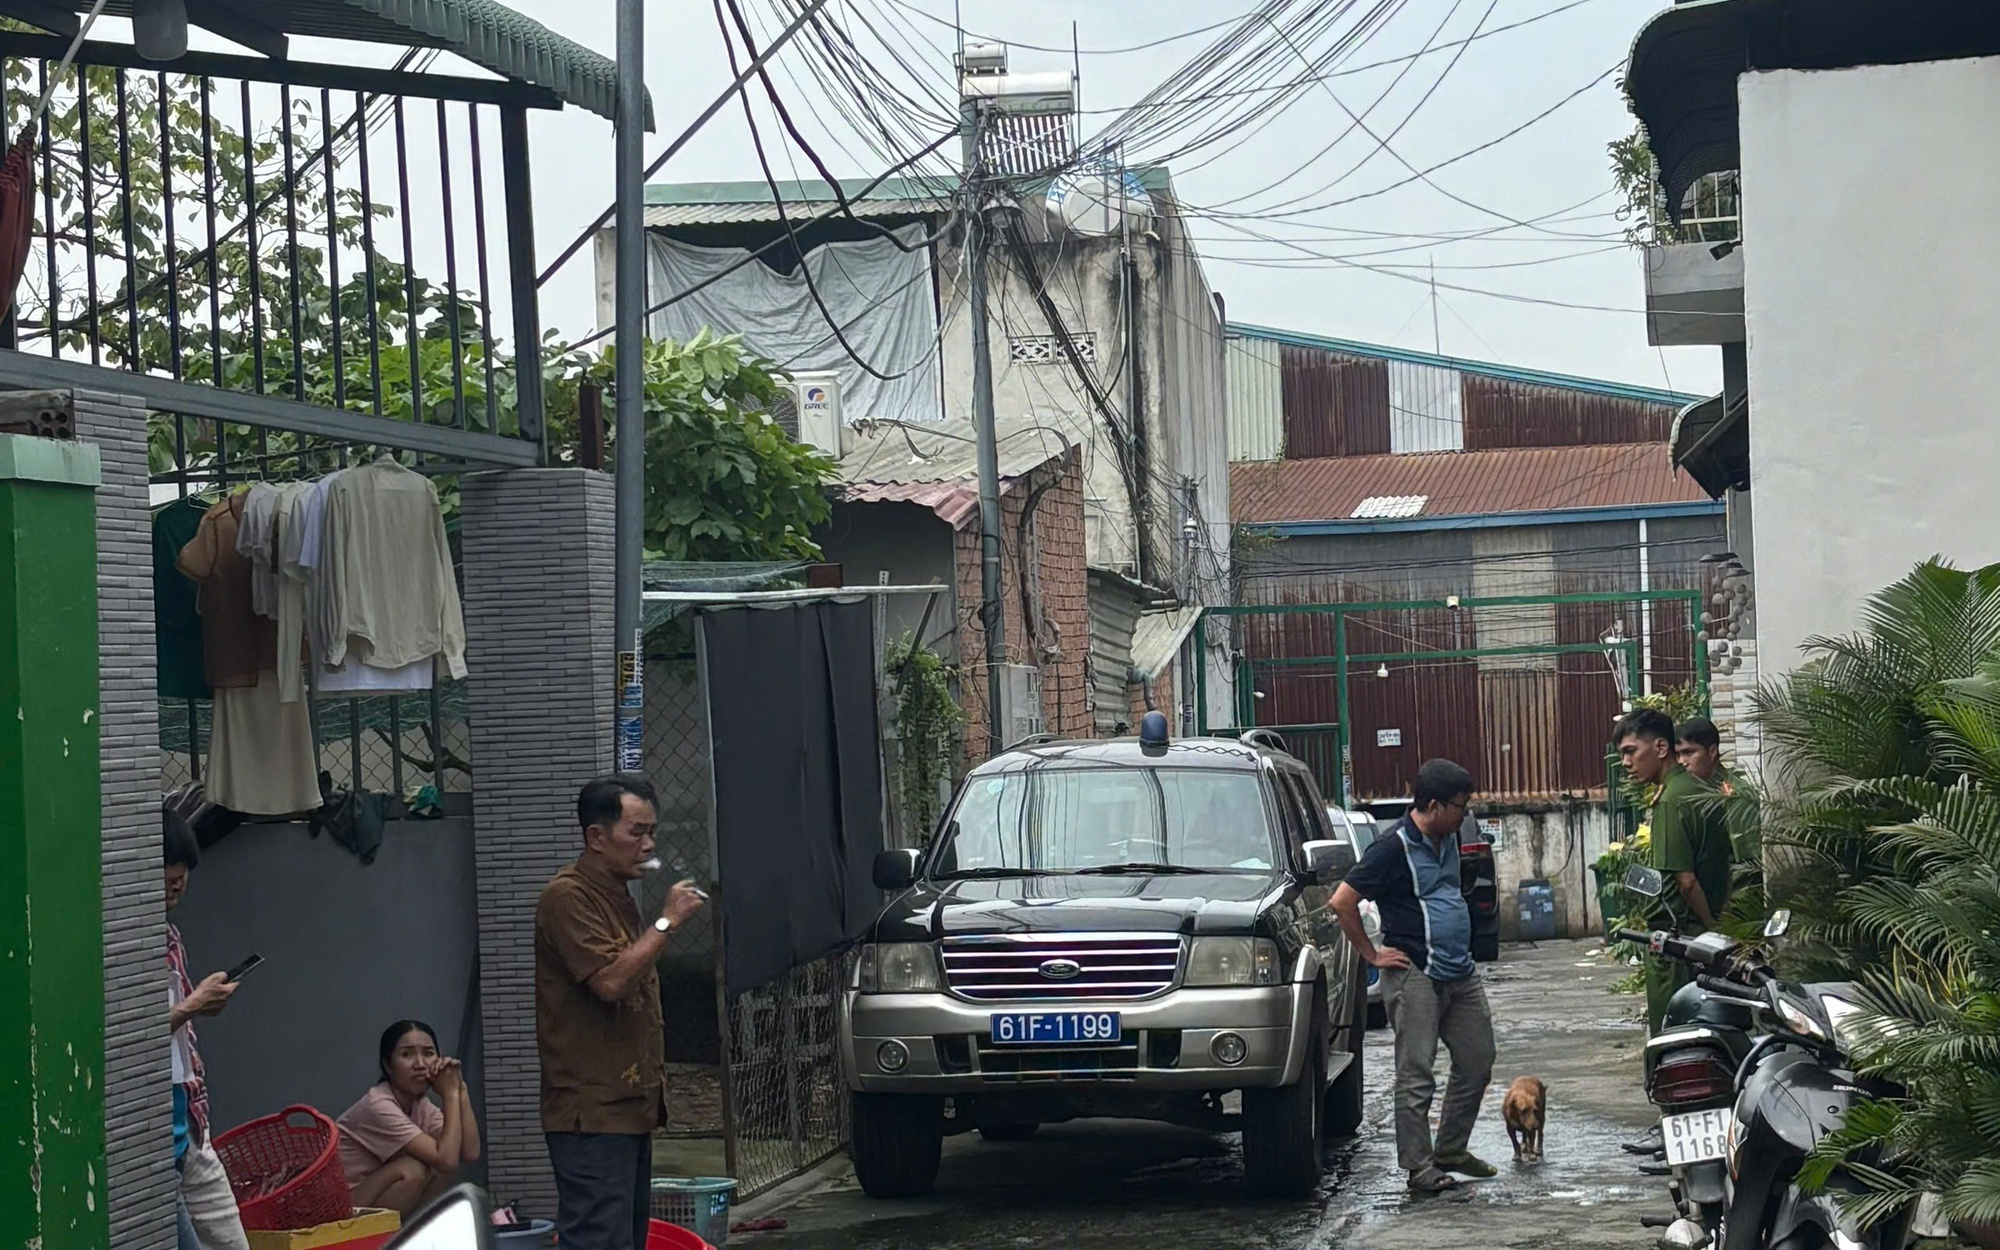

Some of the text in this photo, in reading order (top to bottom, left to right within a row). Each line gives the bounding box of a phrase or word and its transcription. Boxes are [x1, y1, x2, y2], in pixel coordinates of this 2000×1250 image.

[1000, 1014, 1112, 1040] 61F-1199
[1832, 1084, 1873, 1097] HONDA
[1671, 1110, 1724, 1138] 61-F1
[1675, 1134, 1727, 1162] 1168
